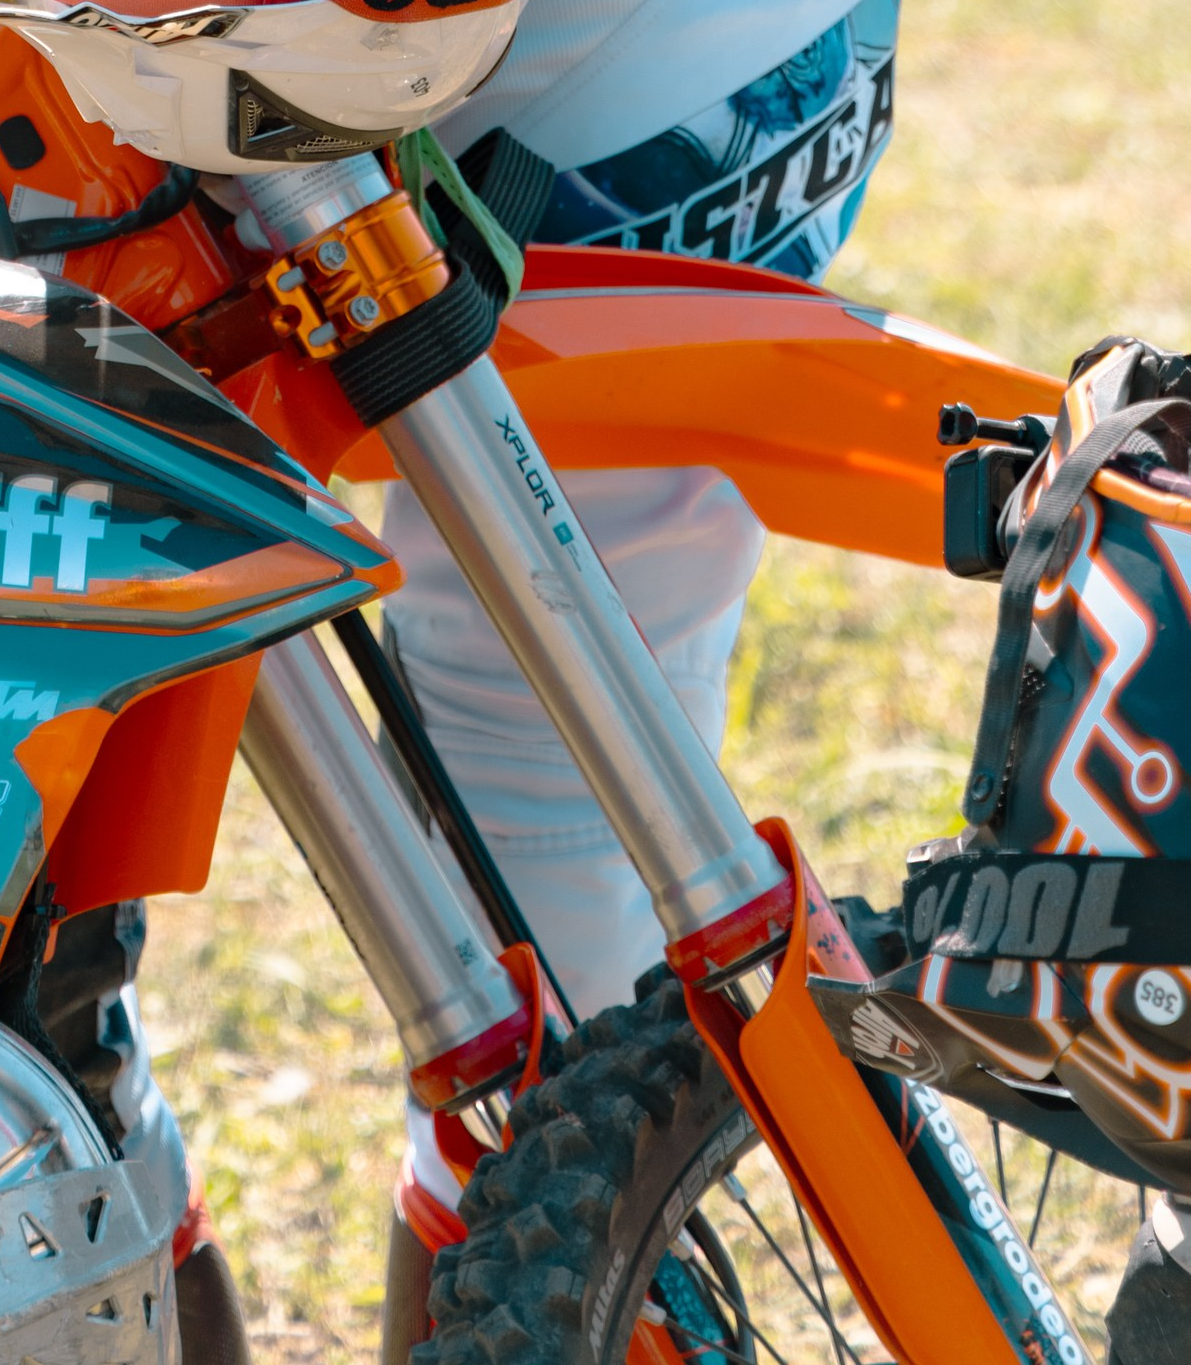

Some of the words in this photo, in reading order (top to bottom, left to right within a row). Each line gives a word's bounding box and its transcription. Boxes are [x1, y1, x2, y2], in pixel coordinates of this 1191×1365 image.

[495, 413, 555, 517] XPLOR
[1140, 980, 1179, 1016] 385
[905, 1079, 1083, 1365] zbergrodeo
